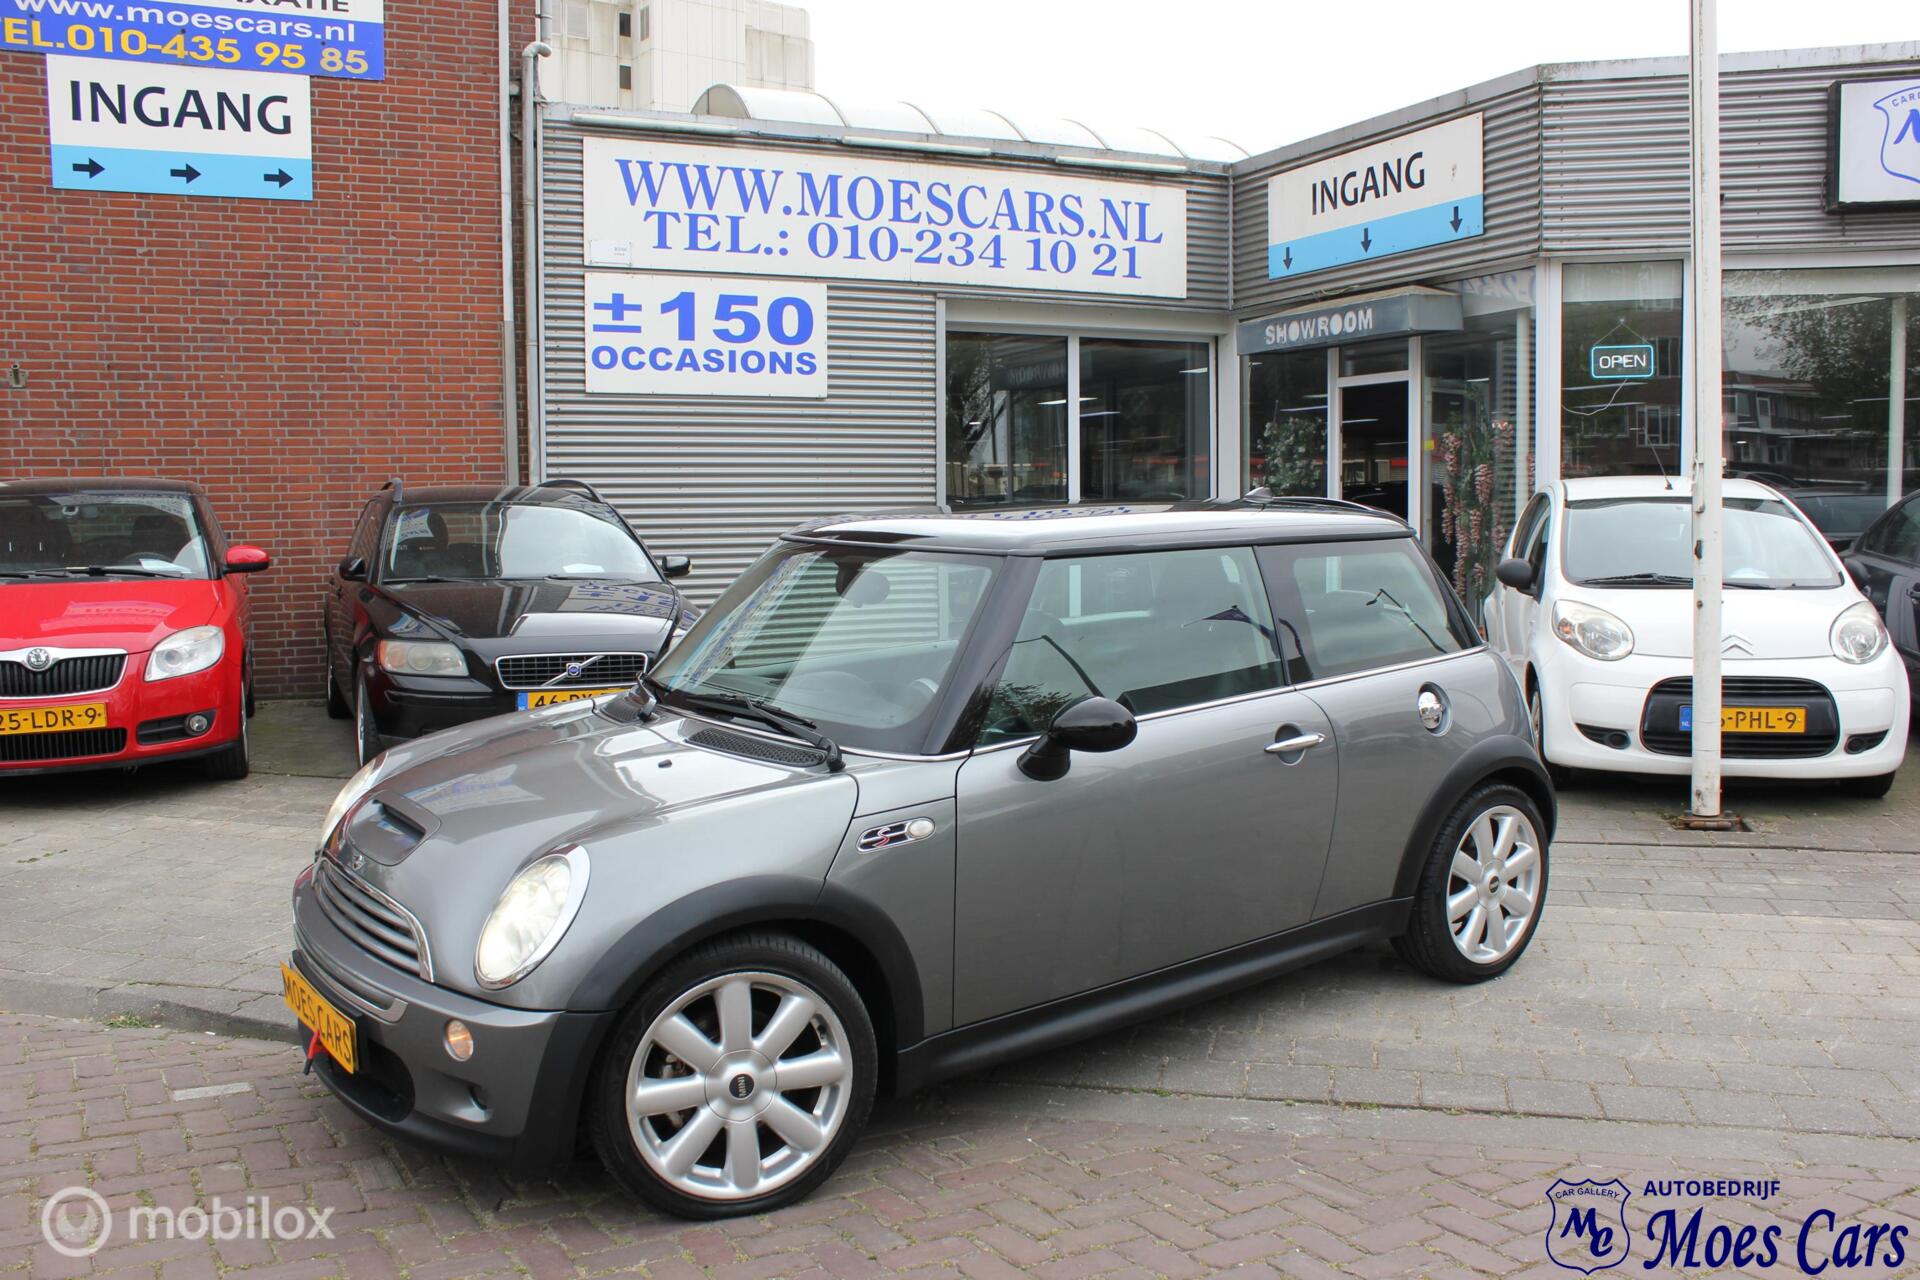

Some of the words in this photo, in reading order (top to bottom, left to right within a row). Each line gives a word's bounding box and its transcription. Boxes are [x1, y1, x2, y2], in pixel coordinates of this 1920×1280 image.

[0, 16, 242, 63] EL.010-435
[255, 42, 306, 69] 95
[319, 47, 369, 74] 85
[70, 80, 291, 135] INGANG
[615, 158, 1164, 244] WWW.MOESCARS.NL
[1312, 151, 1425, 215] INGANG
[643, 209, 790, 257] TEL.:
[807, 221, 1007, 269] 010-234
[1026, 237, 1077, 274] 10
[1092, 243, 1142, 279] 21
[1264, 307, 1373, 345] SHOWROOM
[591, 344, 817, 376] OCCASIONS
[1599, 354, 1647, 369] OPEN
